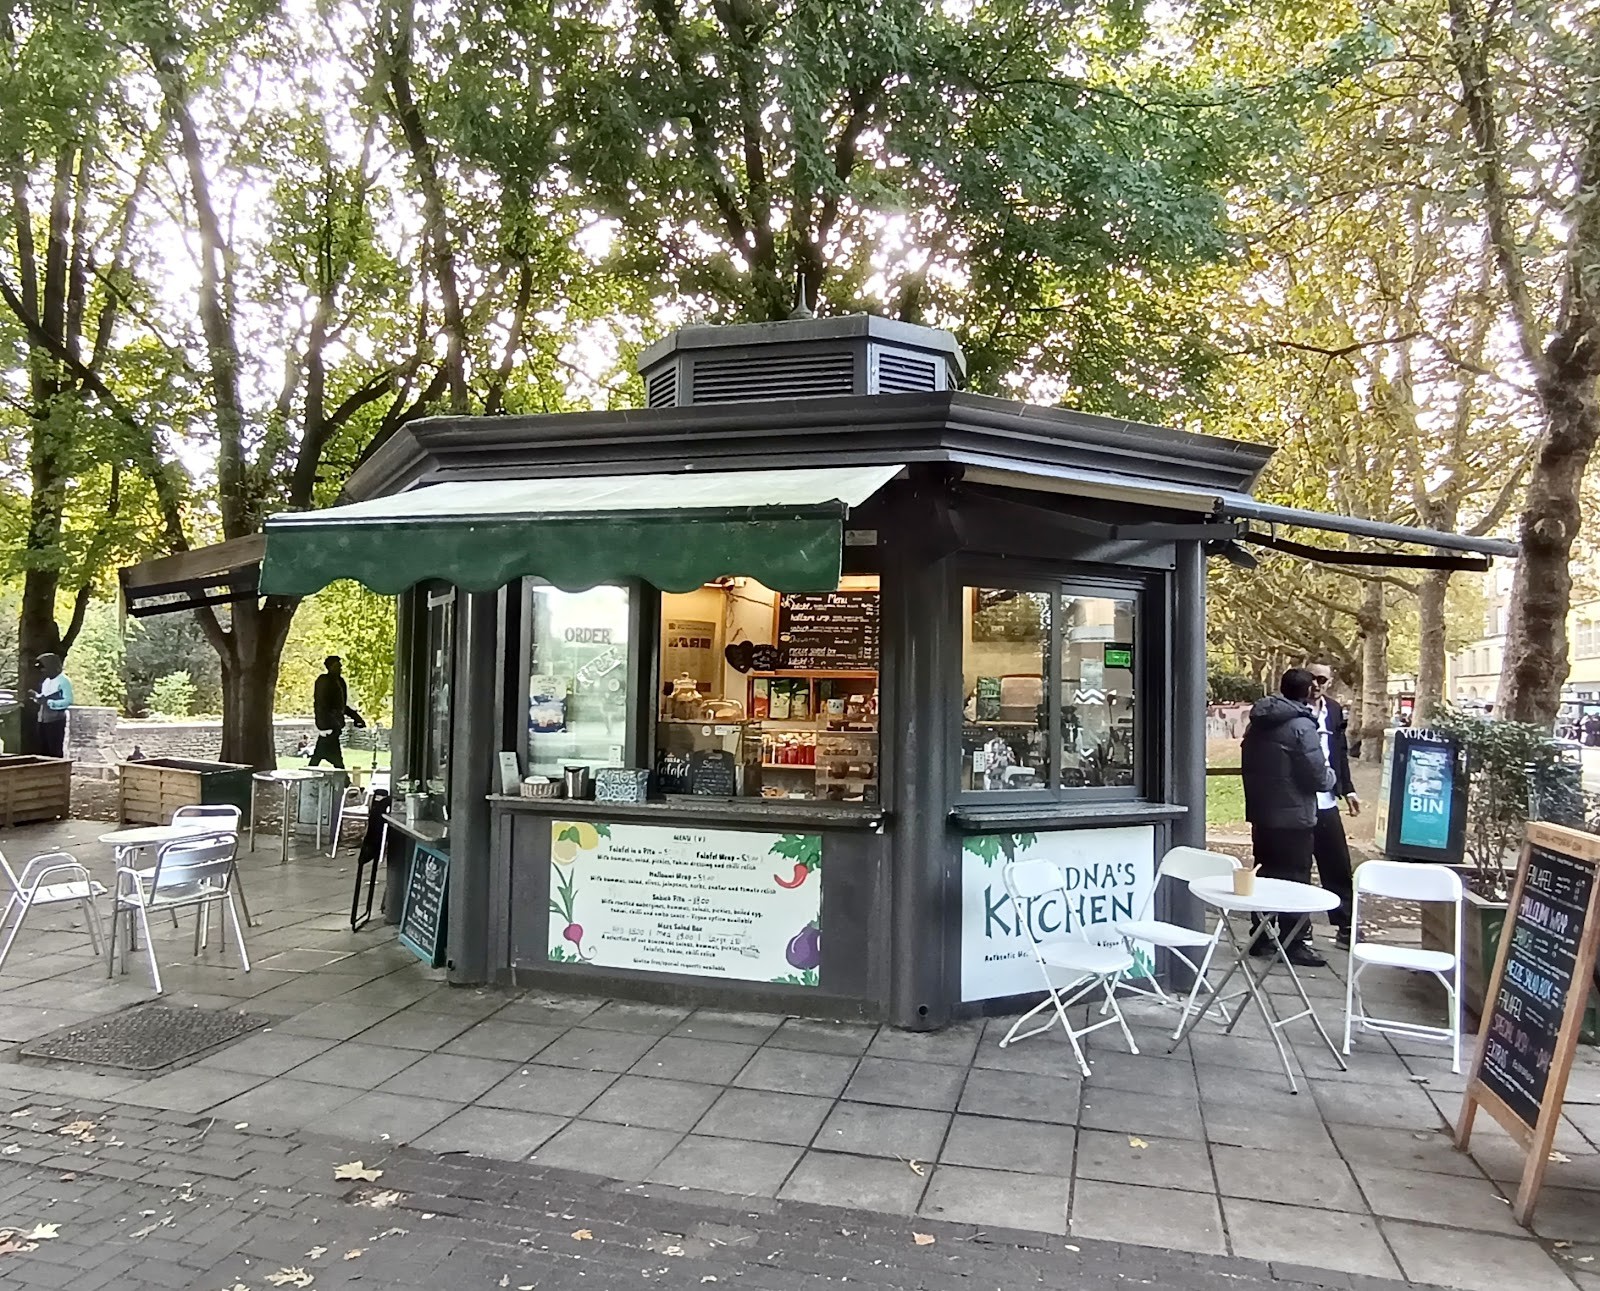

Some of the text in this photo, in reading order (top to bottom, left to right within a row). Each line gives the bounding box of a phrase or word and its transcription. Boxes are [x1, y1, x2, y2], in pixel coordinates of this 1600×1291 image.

[564, 627, 611, 645] ORDER
[1410, 796, 1444, 814] BIN
[609, 844, 629, 853] Falafel
[696, 850, 717, 859] Falafel
[718, 853, 734, 861] Wrap
[675, 872, 691, 881] Wrap
[673, 923, 690, 931] Salad
